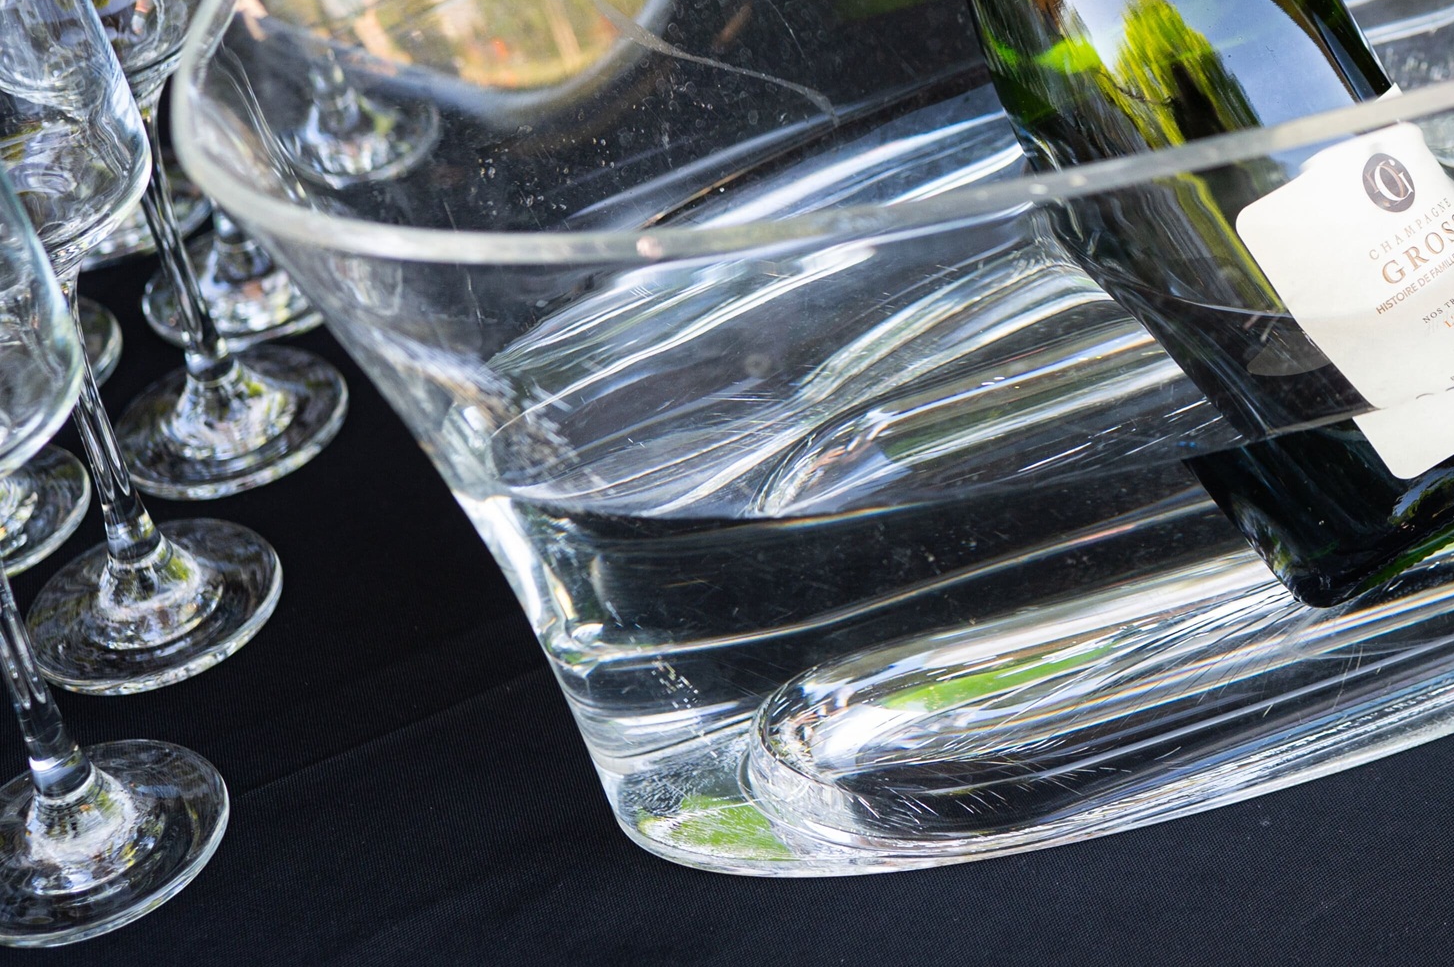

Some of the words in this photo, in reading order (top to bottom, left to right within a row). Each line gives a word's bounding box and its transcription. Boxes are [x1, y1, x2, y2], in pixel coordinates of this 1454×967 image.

[1369, 198, 1452, 260] CHAMPAGNE
[1375, 282, 1419, 315] HISTOIRE
[1418, 274, 1432, 288] DE
[1422, 307, 1443, 324] NOS
